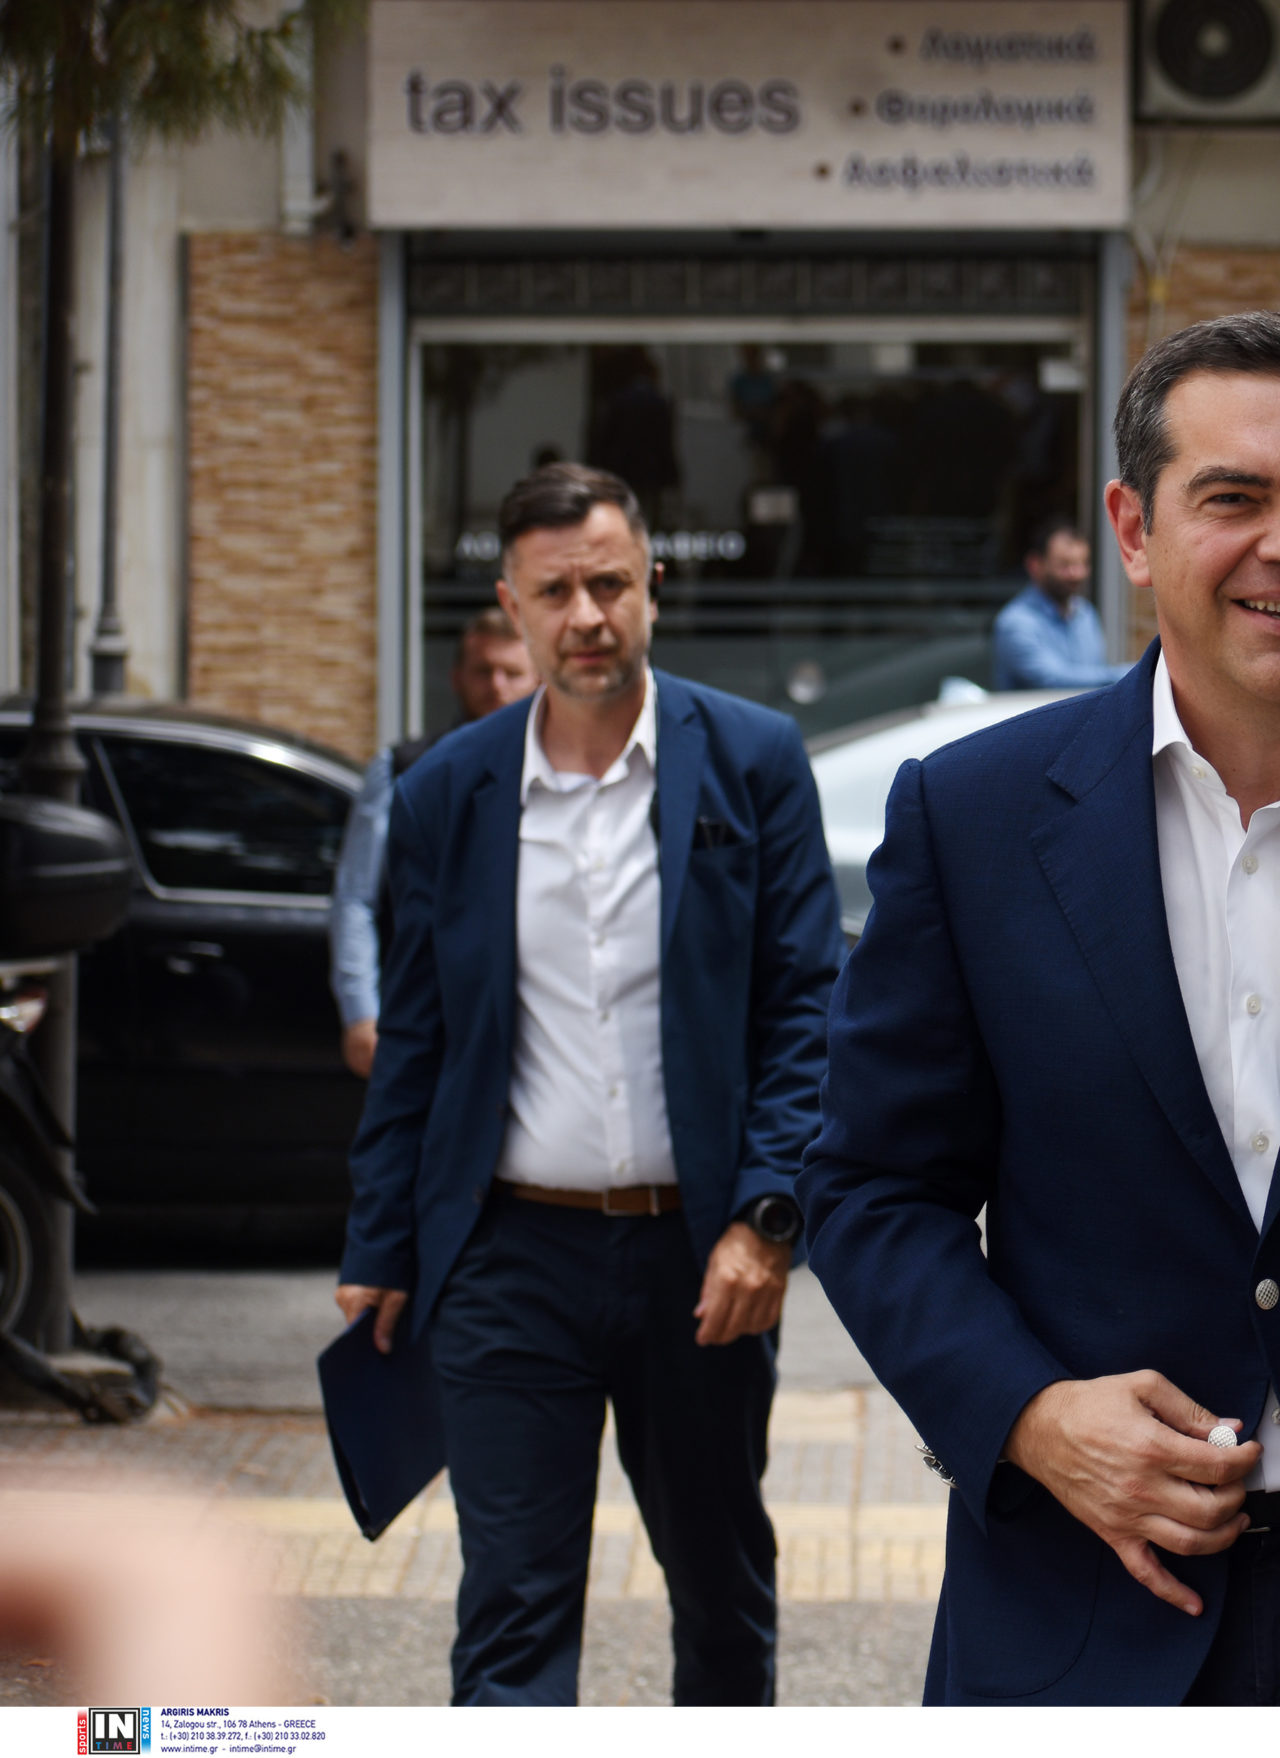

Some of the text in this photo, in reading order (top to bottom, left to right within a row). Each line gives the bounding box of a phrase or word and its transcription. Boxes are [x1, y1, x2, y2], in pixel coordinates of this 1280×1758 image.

[405, 64, 801, 135] tax issues
[650, 530, 746, 560] ΑΦΕΙΟ
